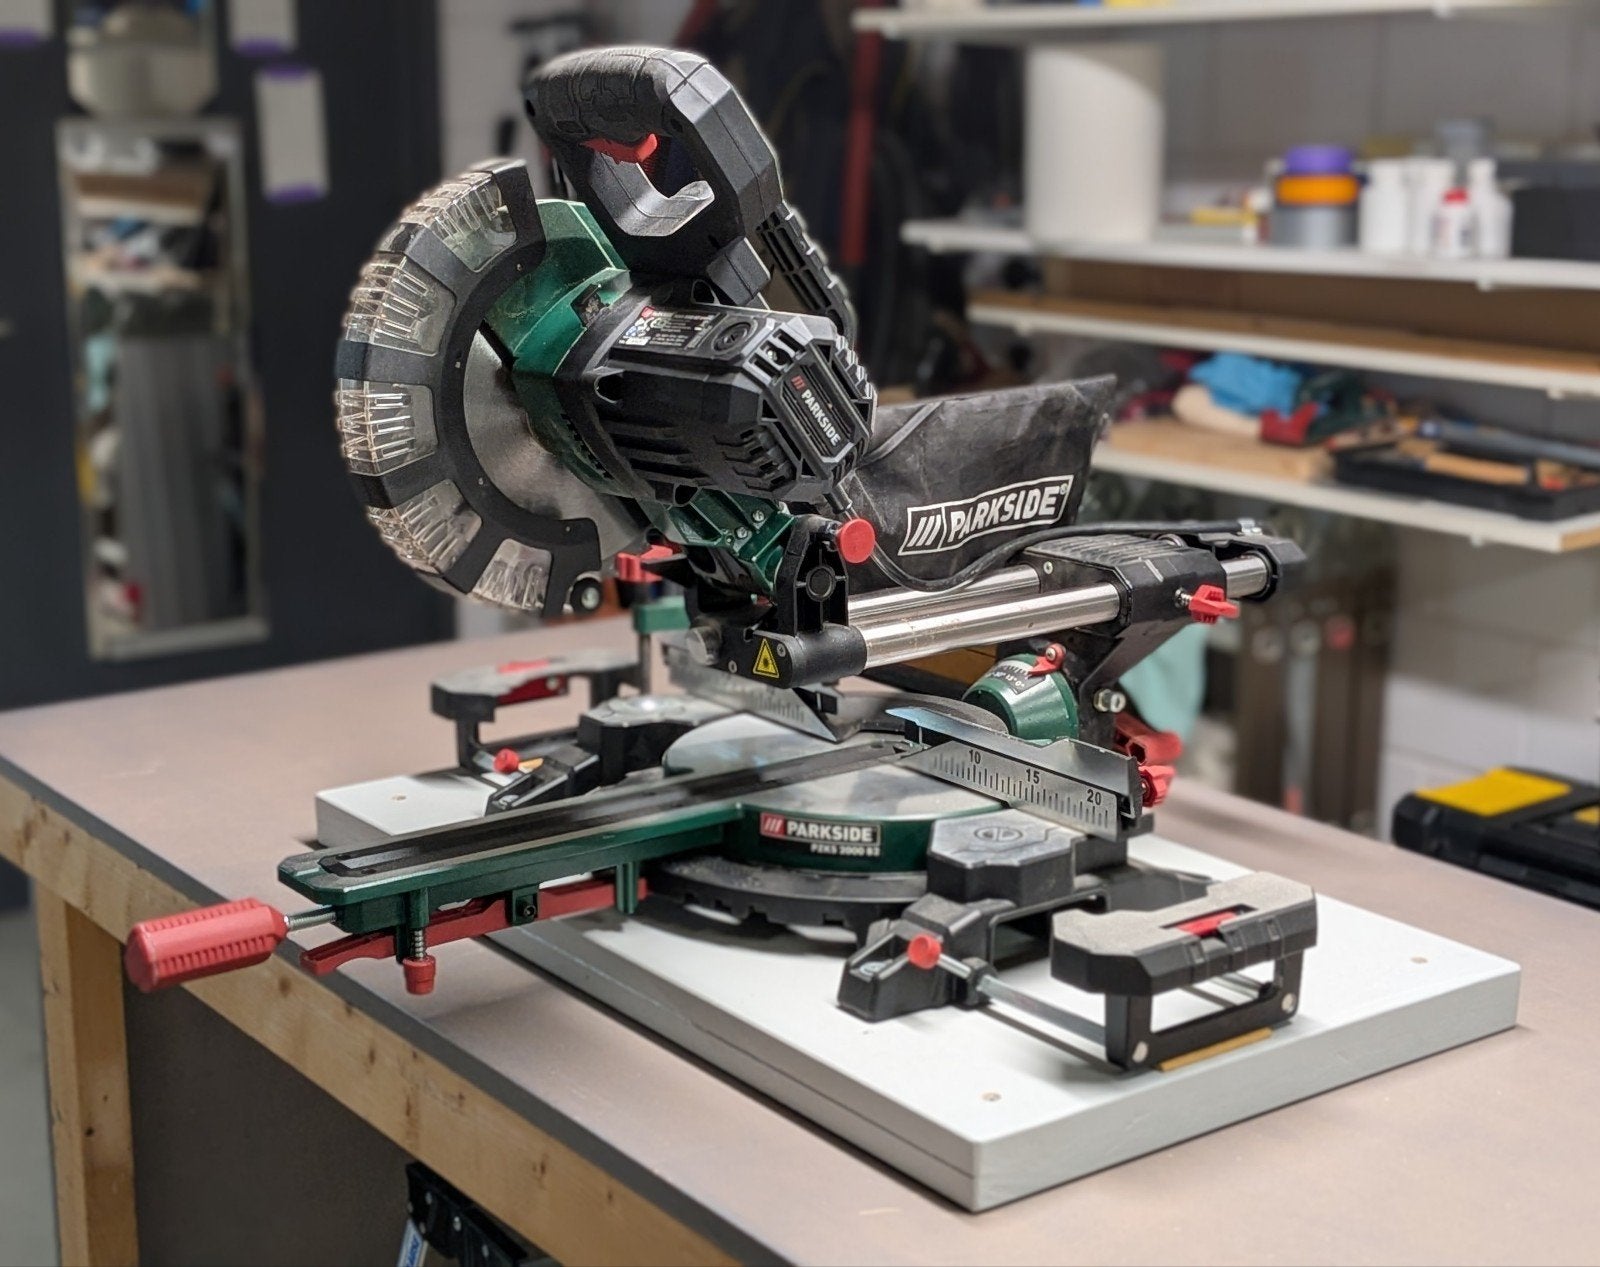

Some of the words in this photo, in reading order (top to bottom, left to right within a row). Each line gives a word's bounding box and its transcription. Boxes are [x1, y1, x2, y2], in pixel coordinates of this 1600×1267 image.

[801, 389, 841, 447] PARKSIDE
[968, 749, 982, 765] 10
[1025, 768, 1041, 785] 15
[1086, 788, 1102, 806] 20
[787, 821, 873, 842] PARKSIDE
